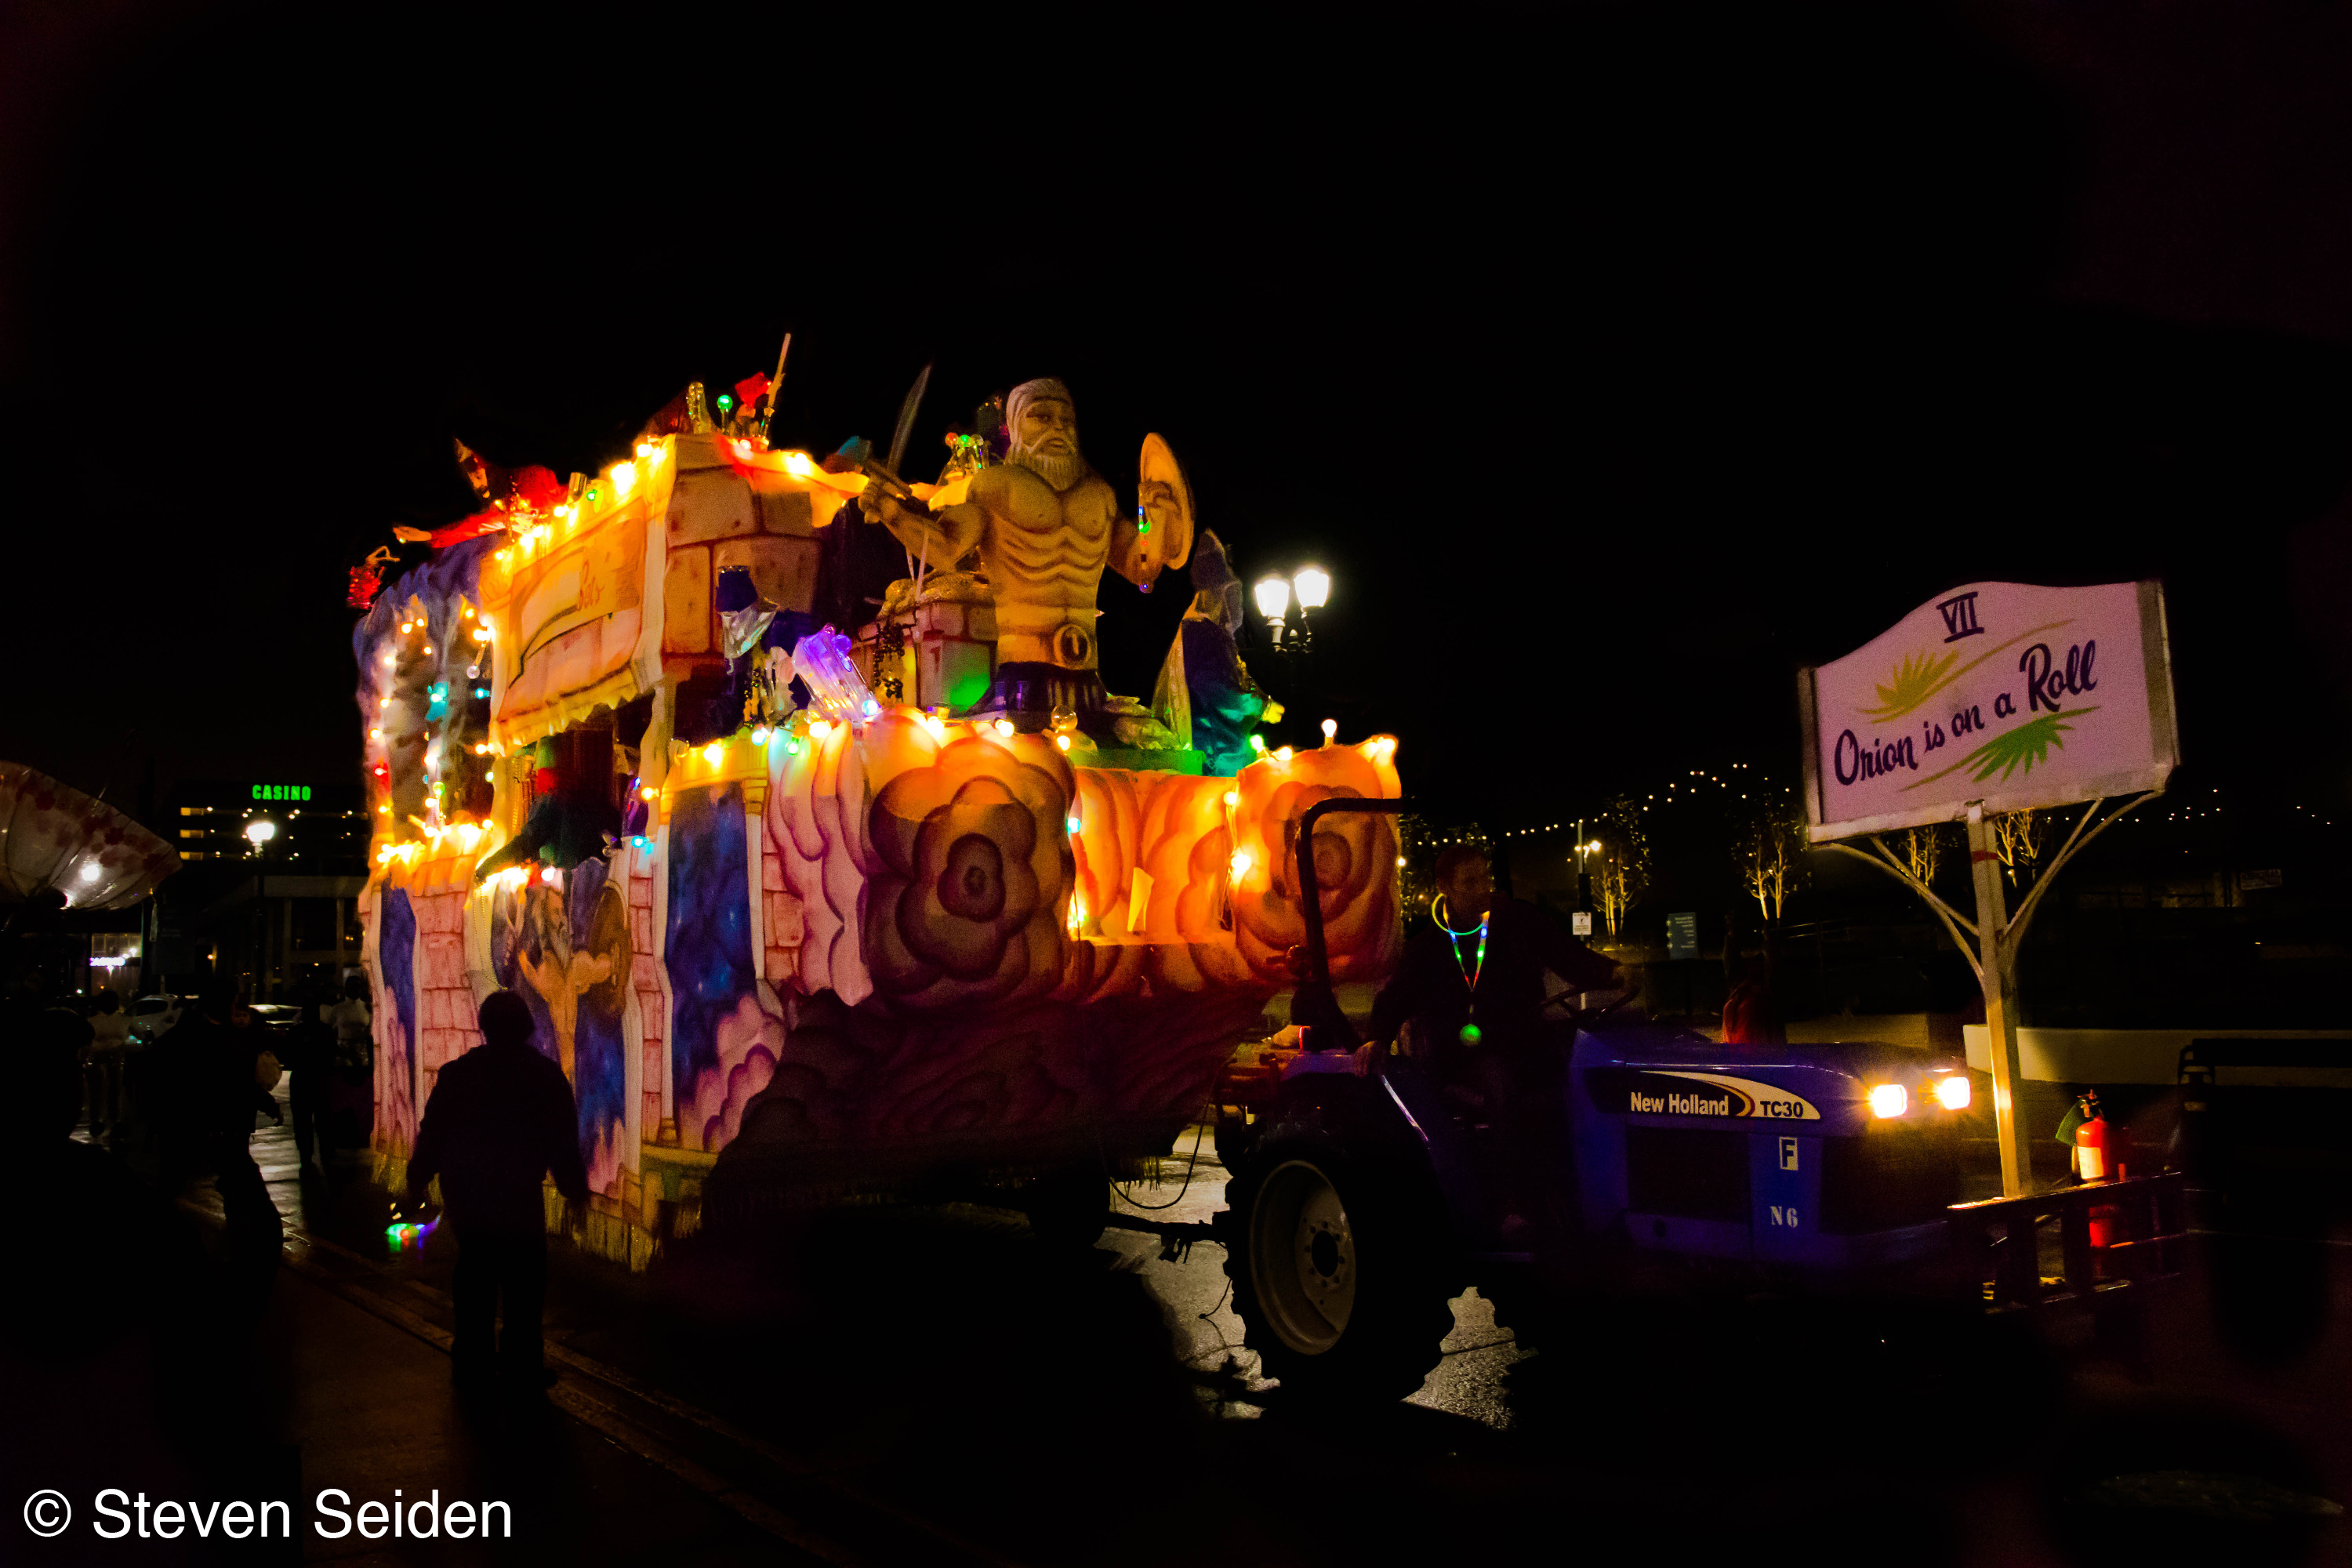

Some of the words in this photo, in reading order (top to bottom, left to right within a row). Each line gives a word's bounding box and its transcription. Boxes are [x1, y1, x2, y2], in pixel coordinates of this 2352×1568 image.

[1936, 591, 1984, 643] VII
[1834, 729, 1918, 786] Orion
[1923, 721, 1946, 753] is
[1951, 705, 1984, 738] on
[1994, 692, 2016, 719] a
[2020, 640, 2098, 713] Roll
[252, 785, 310, 800] CASINO
[1631, 1091, 1664, 1112] New
[1668, 1093, 1730, 1116] Holland
[1760, 1100, 1804, 1118] TC30
[1781, 1139, 1795, 1168] F
